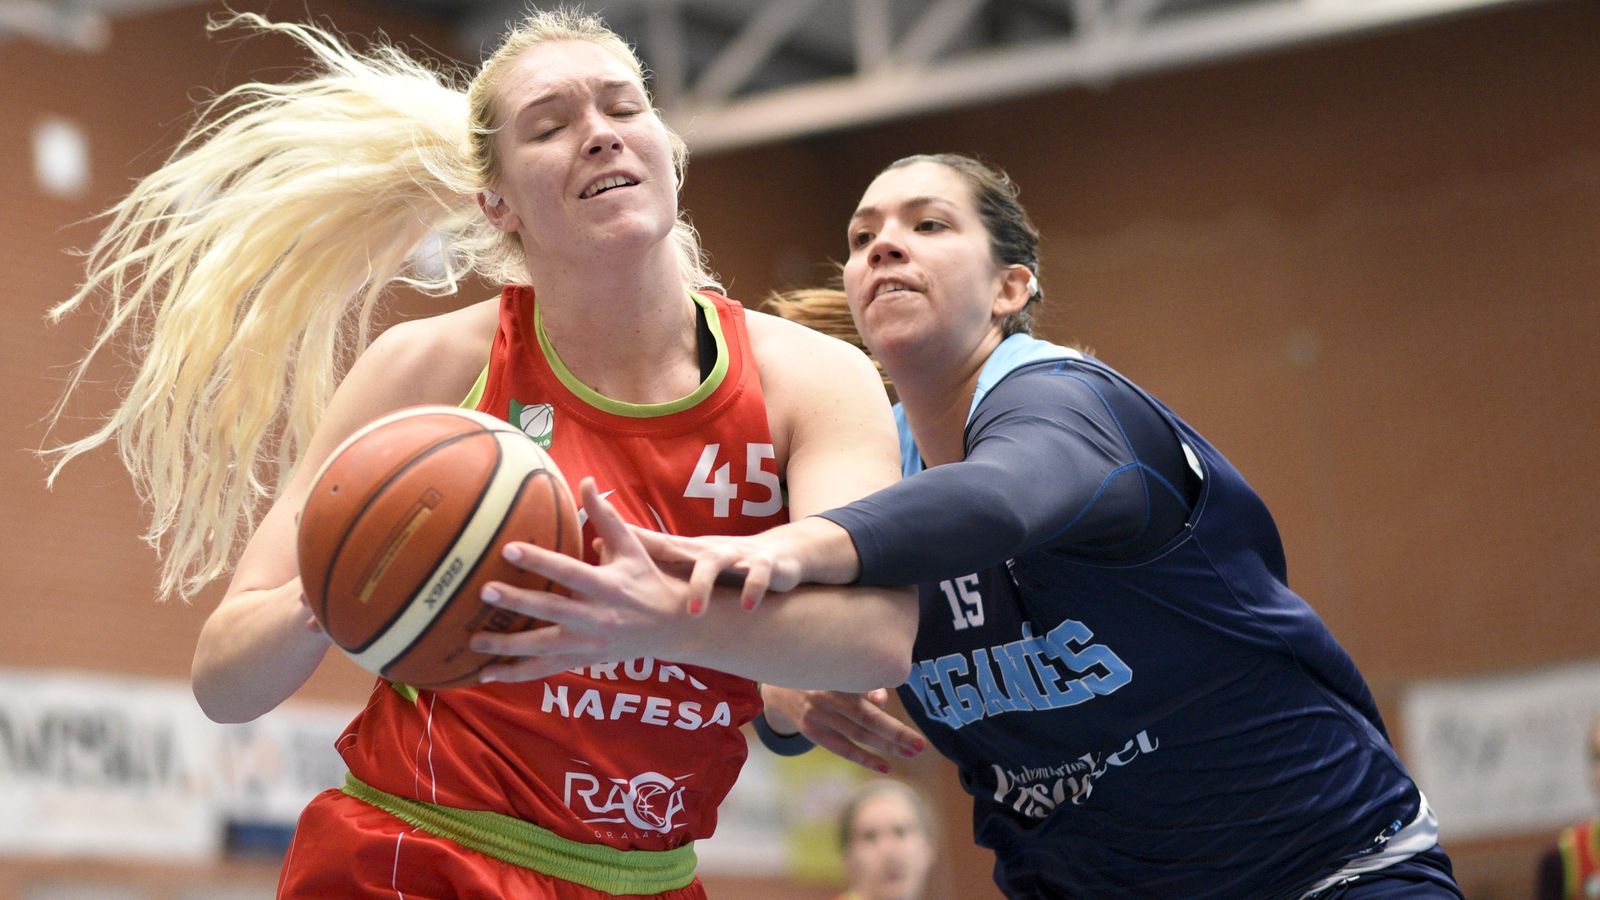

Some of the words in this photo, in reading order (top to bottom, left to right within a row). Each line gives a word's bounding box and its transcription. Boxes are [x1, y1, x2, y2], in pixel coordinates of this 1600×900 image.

[683, 443, 782, 518] 45
[940, 572, 984, 631] 15
[541, 681, 731, 731] HAFESA
